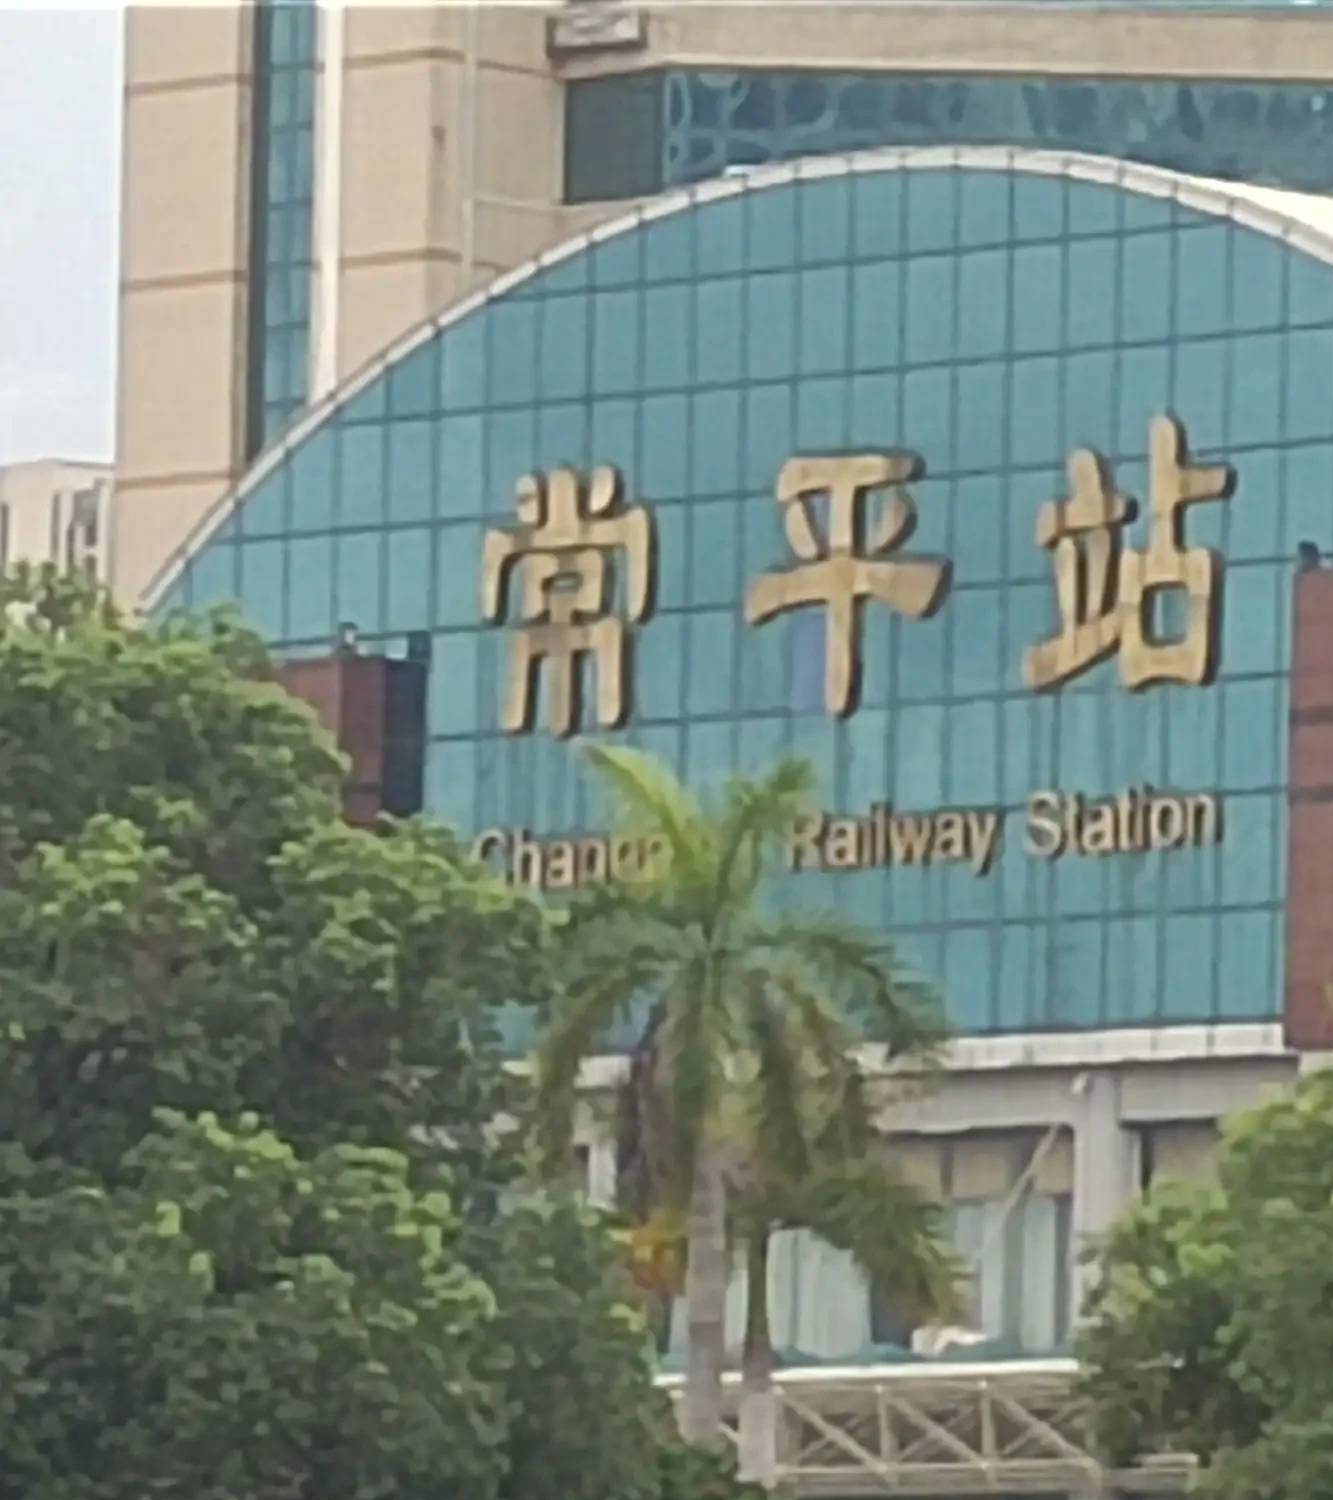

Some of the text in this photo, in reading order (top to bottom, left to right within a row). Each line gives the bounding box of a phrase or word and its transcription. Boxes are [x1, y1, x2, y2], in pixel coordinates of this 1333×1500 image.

[482, 408, 1237, 737] 常平站
[786, 803, 1000, 876] Railway
[1023, 785, 1224, 858] Station
